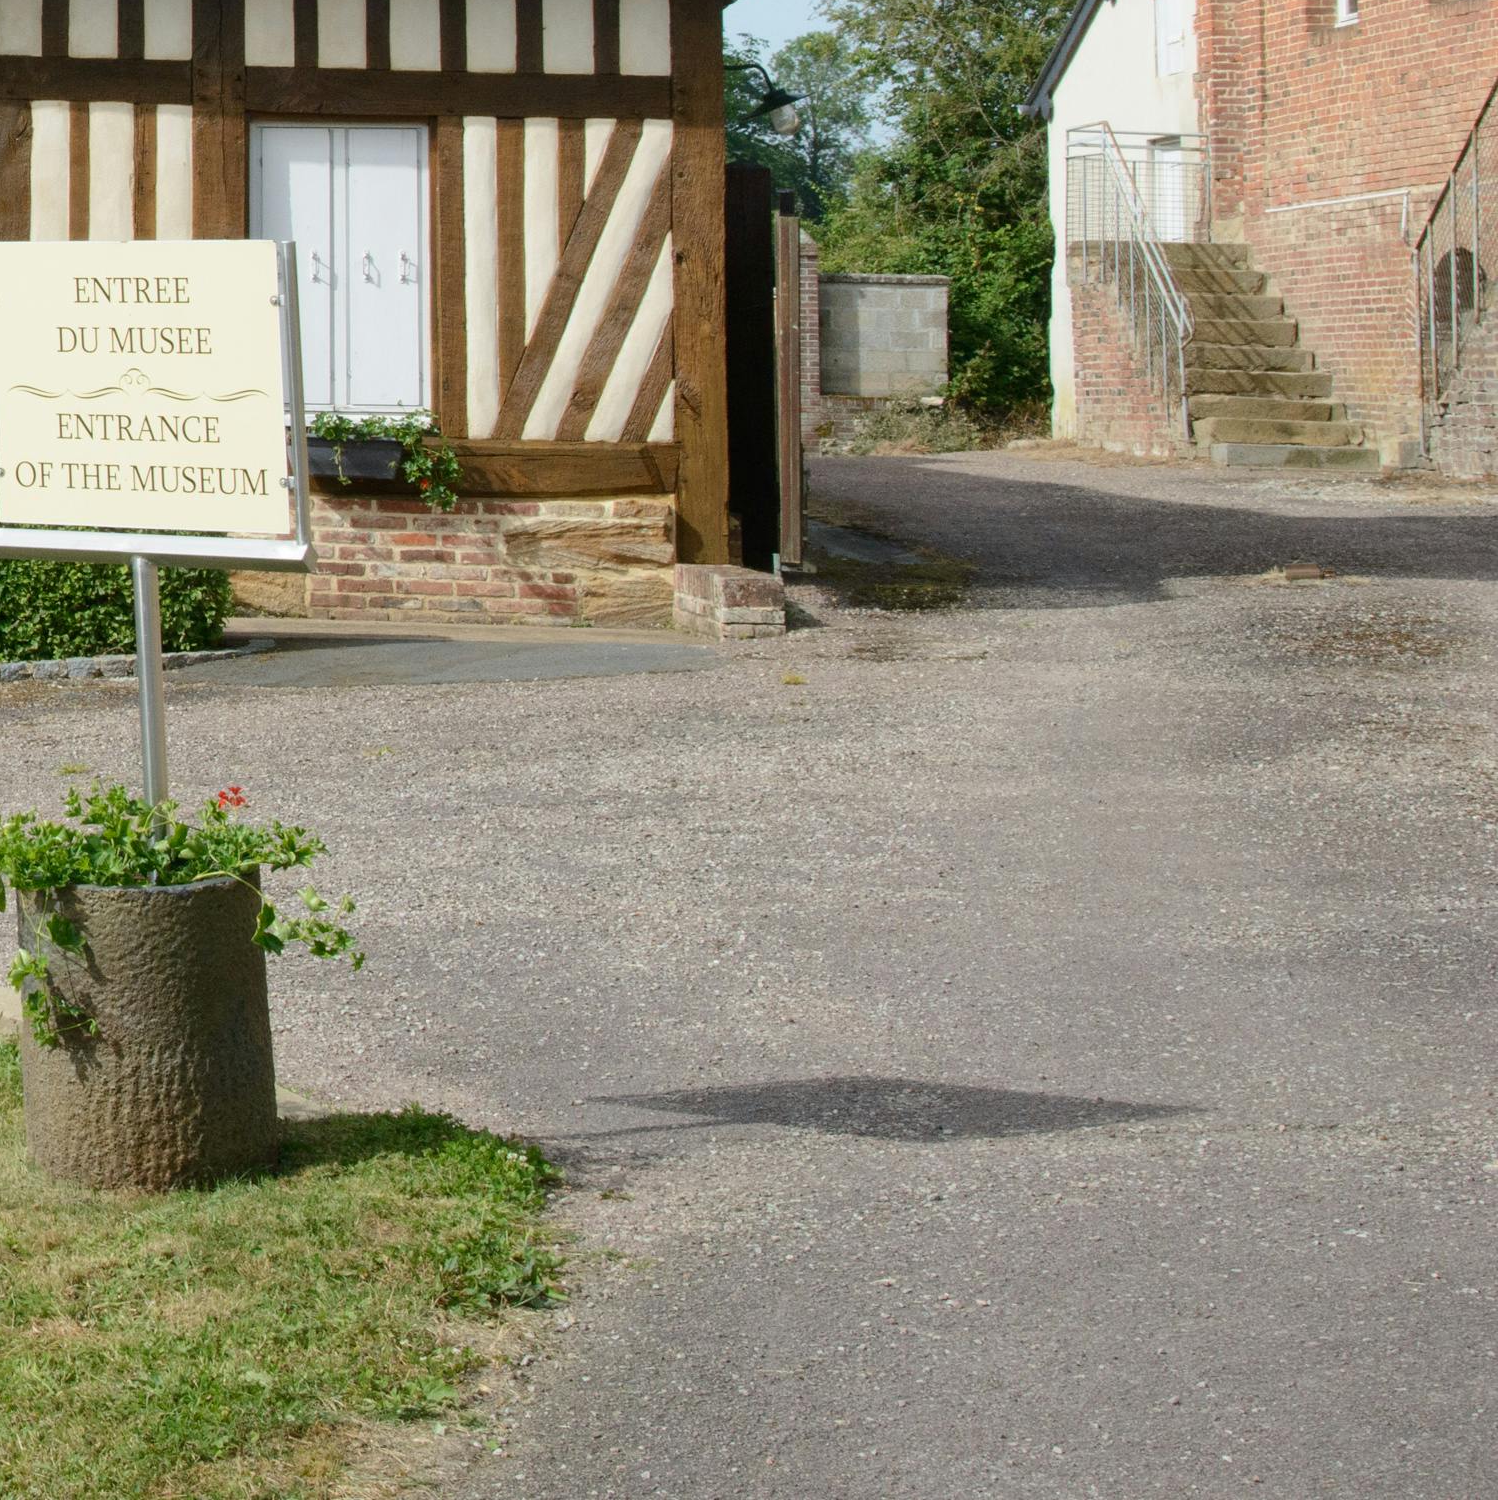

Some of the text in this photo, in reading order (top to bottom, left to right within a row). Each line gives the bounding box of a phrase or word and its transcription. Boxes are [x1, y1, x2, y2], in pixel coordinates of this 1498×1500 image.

[72, 276, 191, 305] ENTREE
[56, 326, 213, 355] DU MUSEE
[56, 412, 221, 444] ENTRANCE
[15, 460, 270, 496] OF THE MUSEUM
